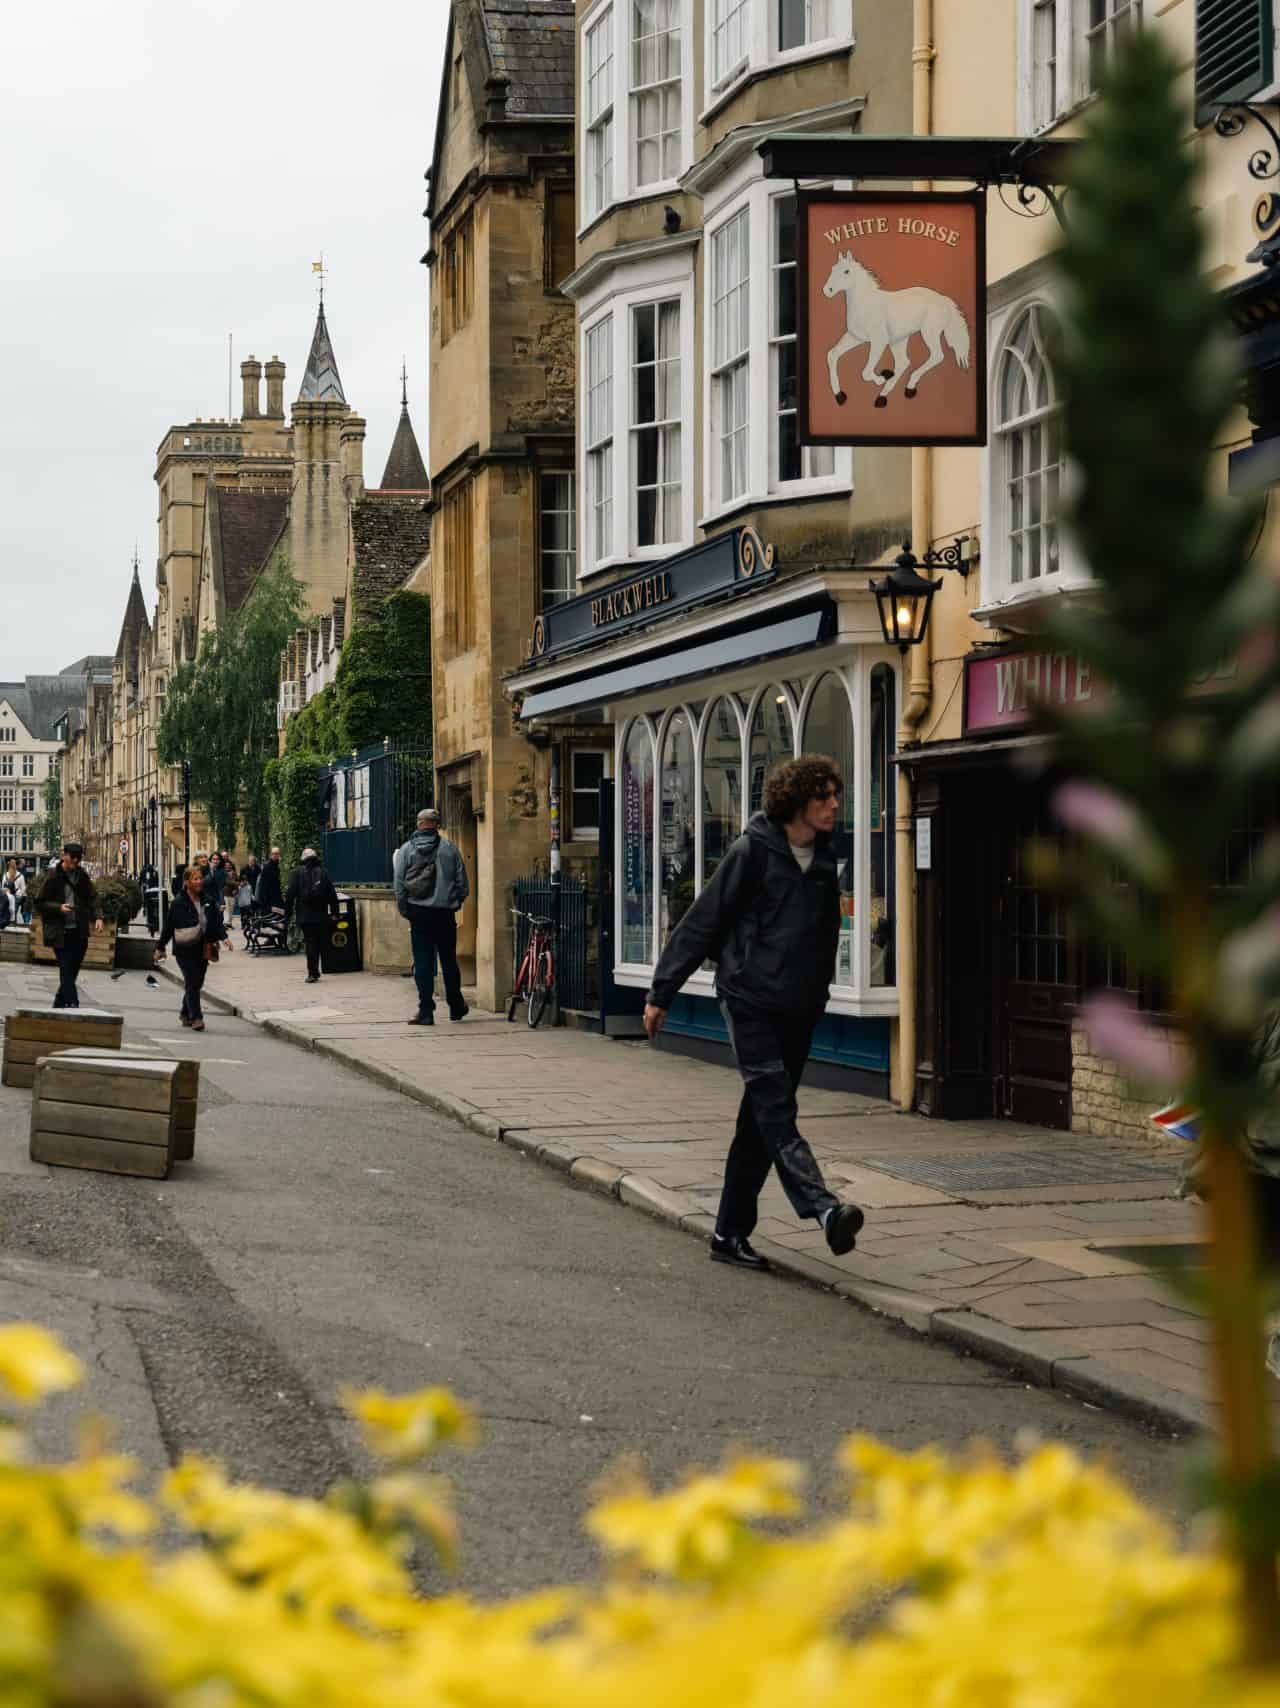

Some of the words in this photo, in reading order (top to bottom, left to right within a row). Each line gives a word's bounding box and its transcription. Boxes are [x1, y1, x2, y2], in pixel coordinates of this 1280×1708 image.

[824, 217, 889, 244] WHITE
[897, 218, 960, 247] HORSE
[591, 573, 671, 625] BLACKWELL
[995, 654, 1093, 713] WHITE
